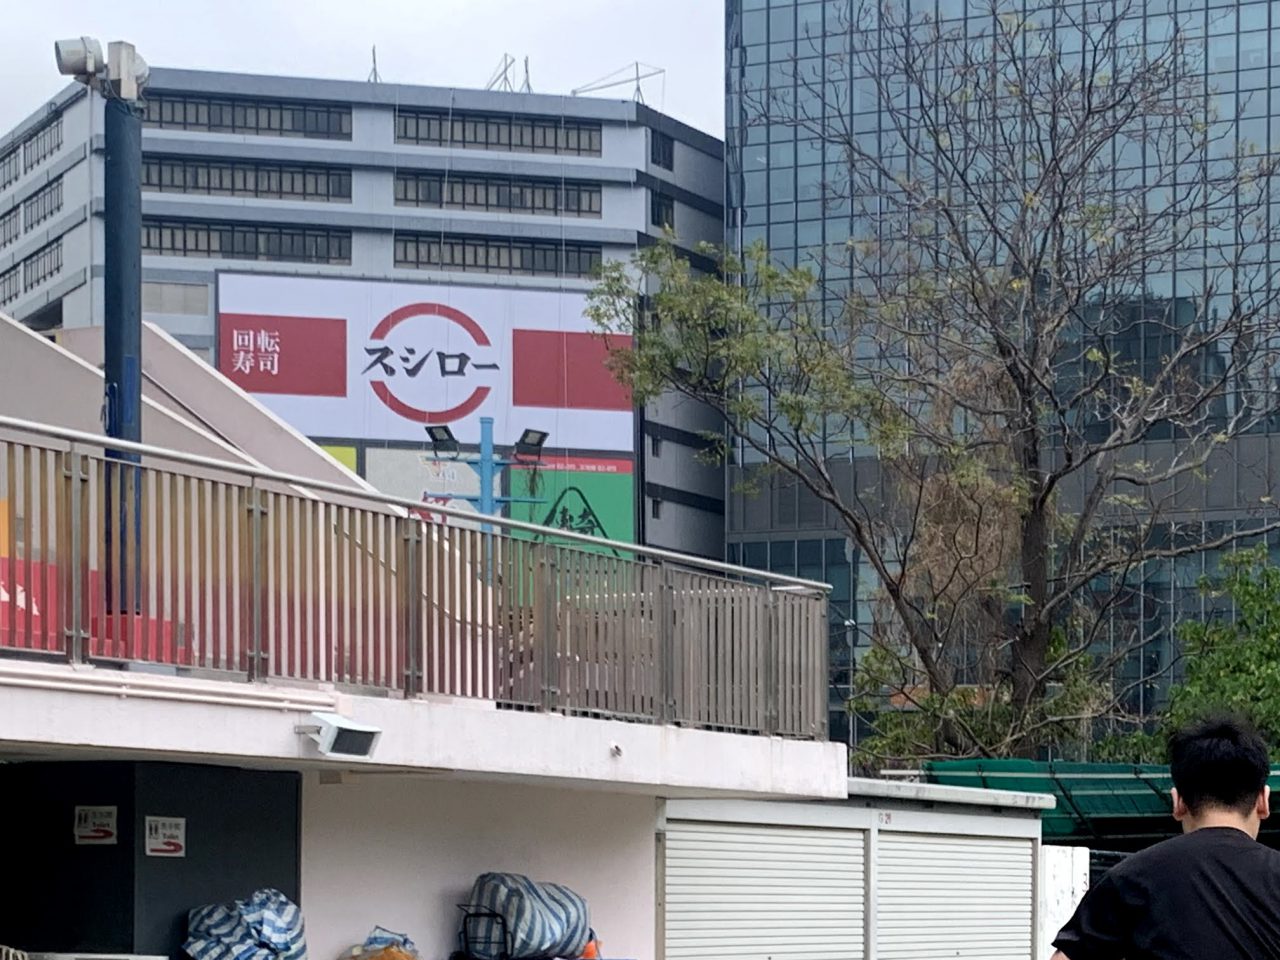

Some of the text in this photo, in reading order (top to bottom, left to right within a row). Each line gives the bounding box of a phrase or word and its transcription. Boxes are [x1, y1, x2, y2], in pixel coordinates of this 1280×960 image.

[232, 328, 280, 352] 回転
[231, 350, 279, 375] 寿司
[361, 345, 501, 377] スシロー
